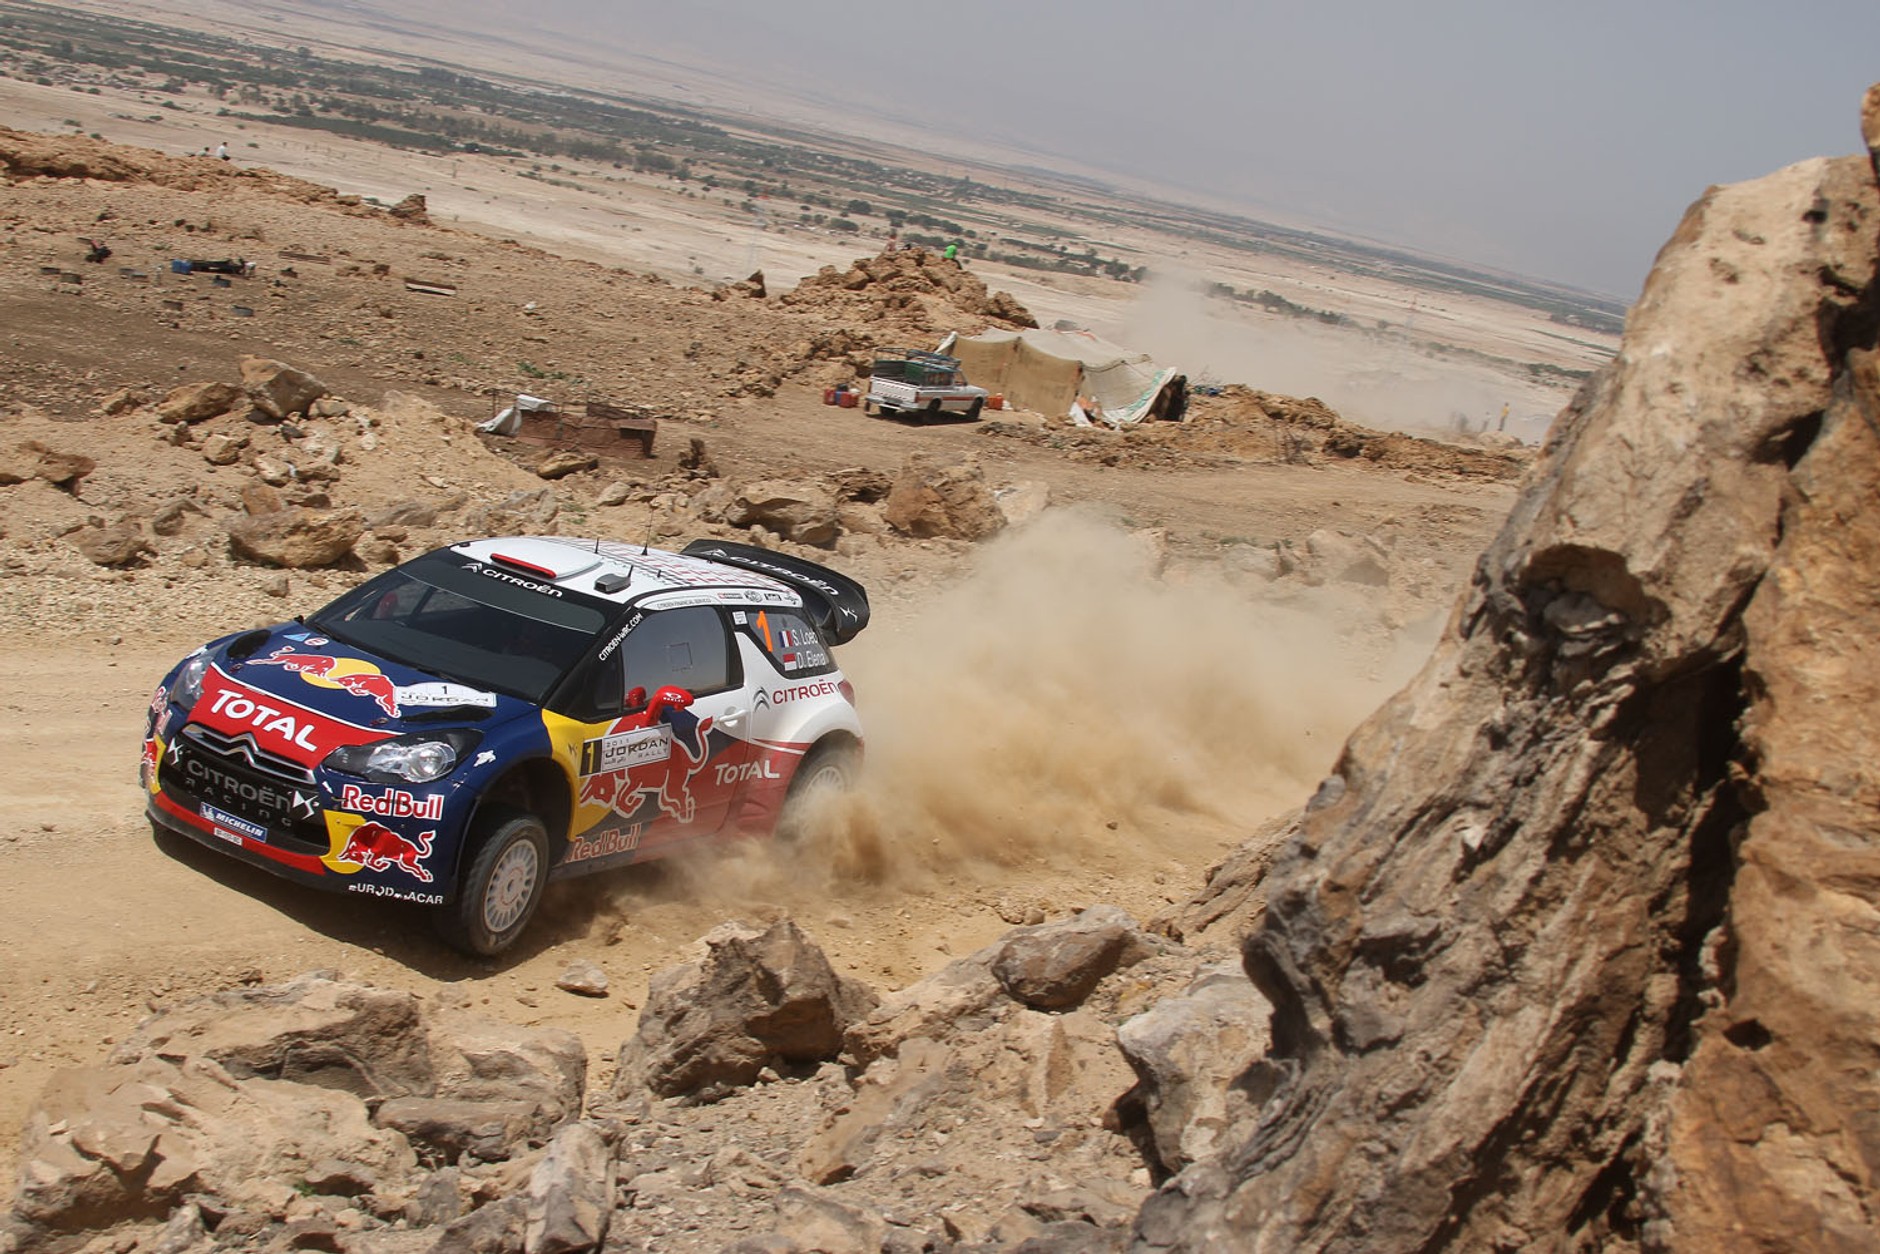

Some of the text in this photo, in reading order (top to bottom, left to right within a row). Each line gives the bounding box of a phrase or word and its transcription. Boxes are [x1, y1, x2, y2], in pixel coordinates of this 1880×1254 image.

[482, 568, 563, 598] CITROËN
[756, 611, 773, 653] 1
[792, 627, 819, 647] S. Loeb
[796, 651, 827, 670] D. Elena
[442, 685, 448, 695] 1
[772, 679, 841, 705] CITROËN
[211, 689, 318, 752] TOTAL
[605, 737, 669, 758] JORDAN
[606, 738, 630, 748] 2011
[638, 748, 667, 758] RALLY
[586, 742, 595, 774] 1
[715, 759, 781, 786] TOTAL
[214, 812, 264, 838] MICHELIN
